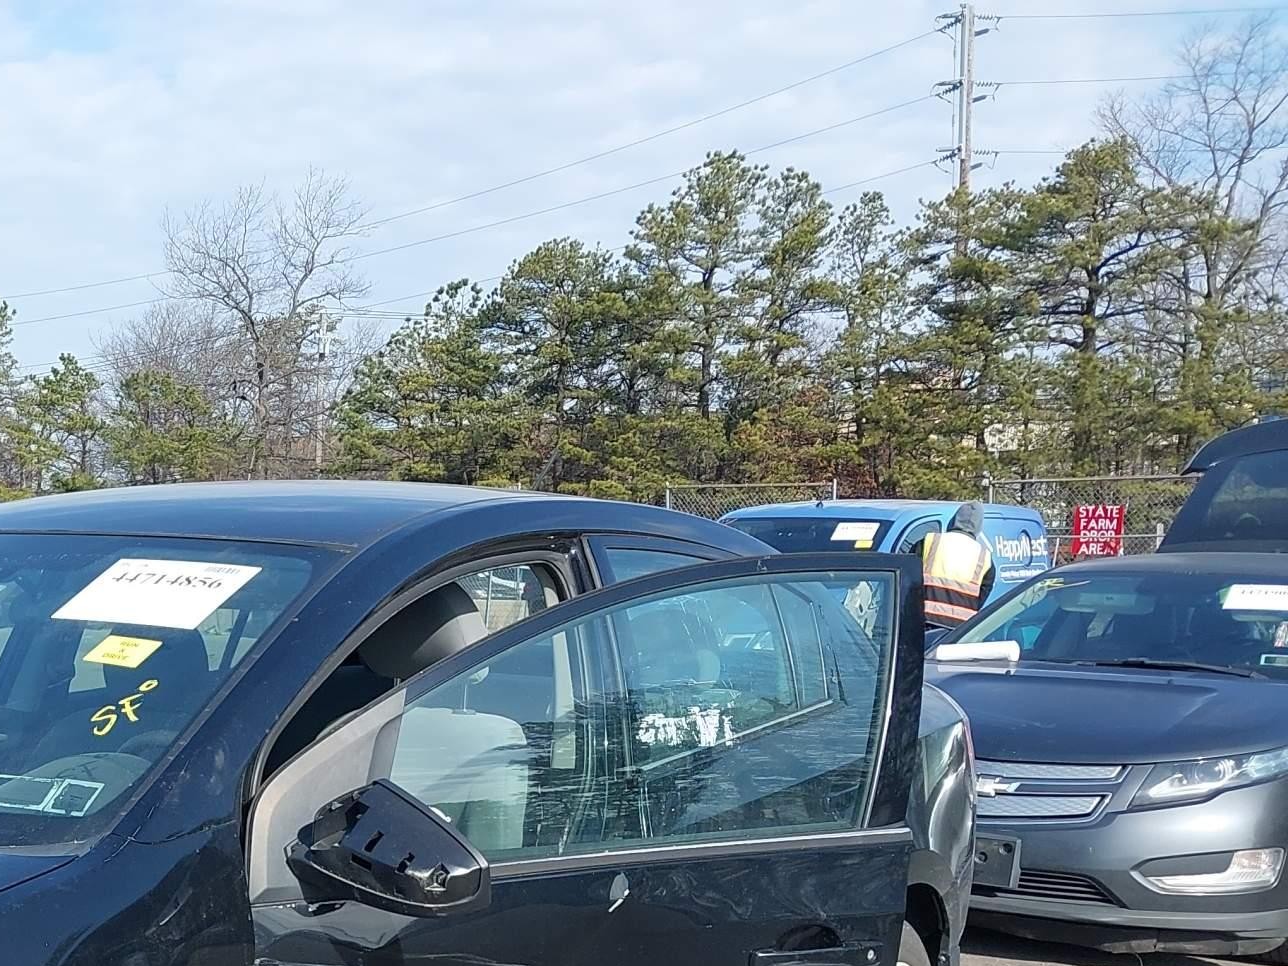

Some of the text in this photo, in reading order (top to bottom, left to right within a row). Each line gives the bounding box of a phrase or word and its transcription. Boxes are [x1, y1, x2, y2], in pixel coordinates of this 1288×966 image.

[1079, 505, 1120, 518] STATE
[1080, 518, 1118, 530] FARM
[1080, 530, 1116, 543] DROP
[1078, 542, 1114, 555] AREA
[112, 571, 222, 589] 44714856
